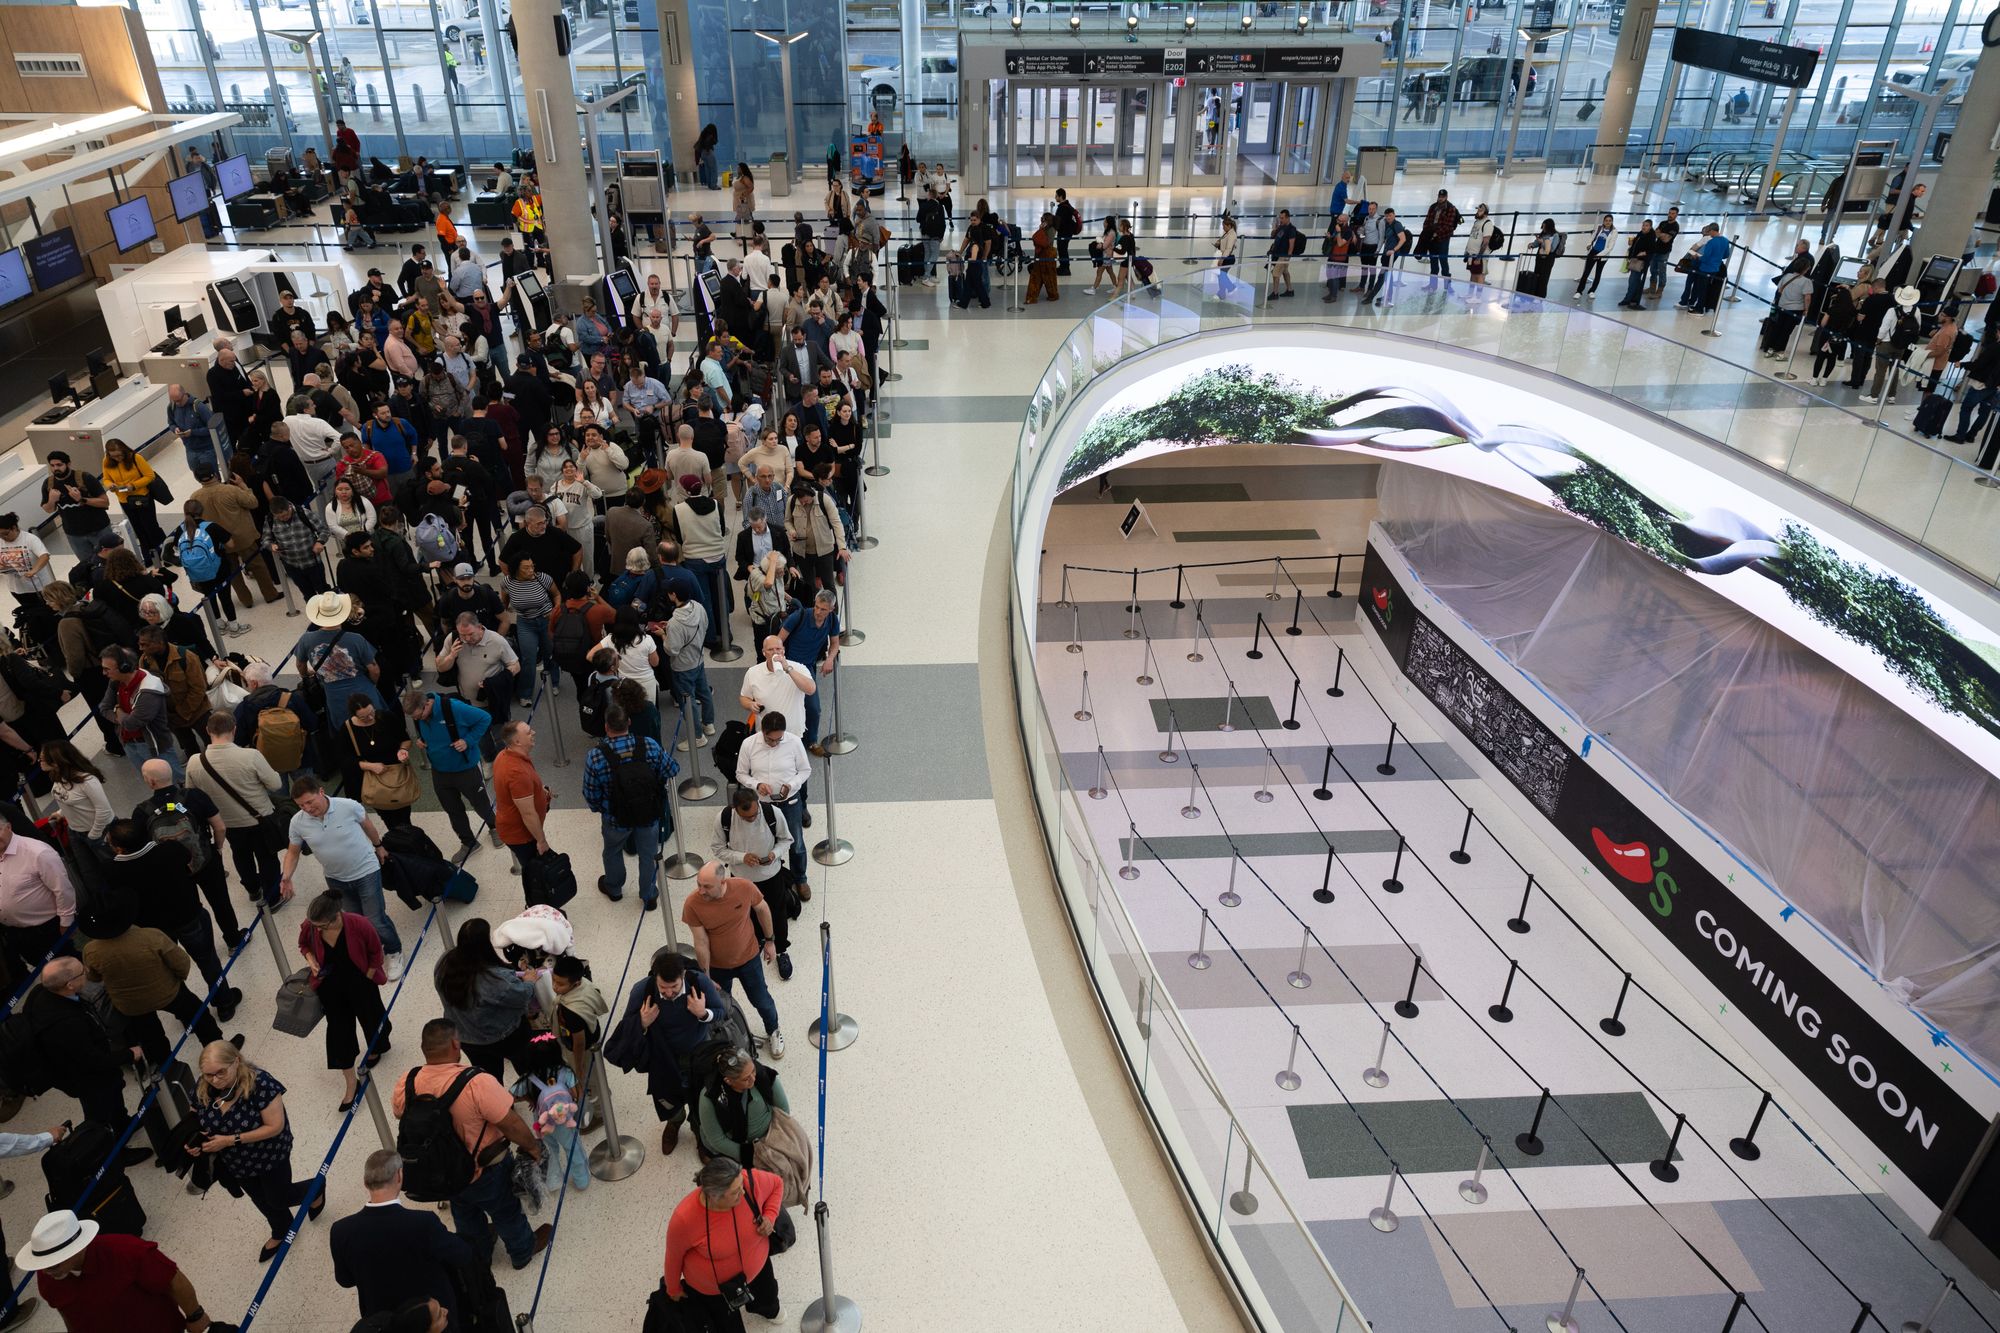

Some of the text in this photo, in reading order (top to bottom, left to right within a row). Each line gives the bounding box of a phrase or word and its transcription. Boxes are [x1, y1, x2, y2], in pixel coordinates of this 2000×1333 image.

[1165, 63, 1184, 71] E202
[1740, 56, 1781, 71] Passenger Pick-Up
[1695, 909, 1940, 1150] COMING SOON
[320, 1162, 331, 1176] IAH
[284, 1229, 297, 1244] IAH
[247, 1301, 261, 1318] IAH
